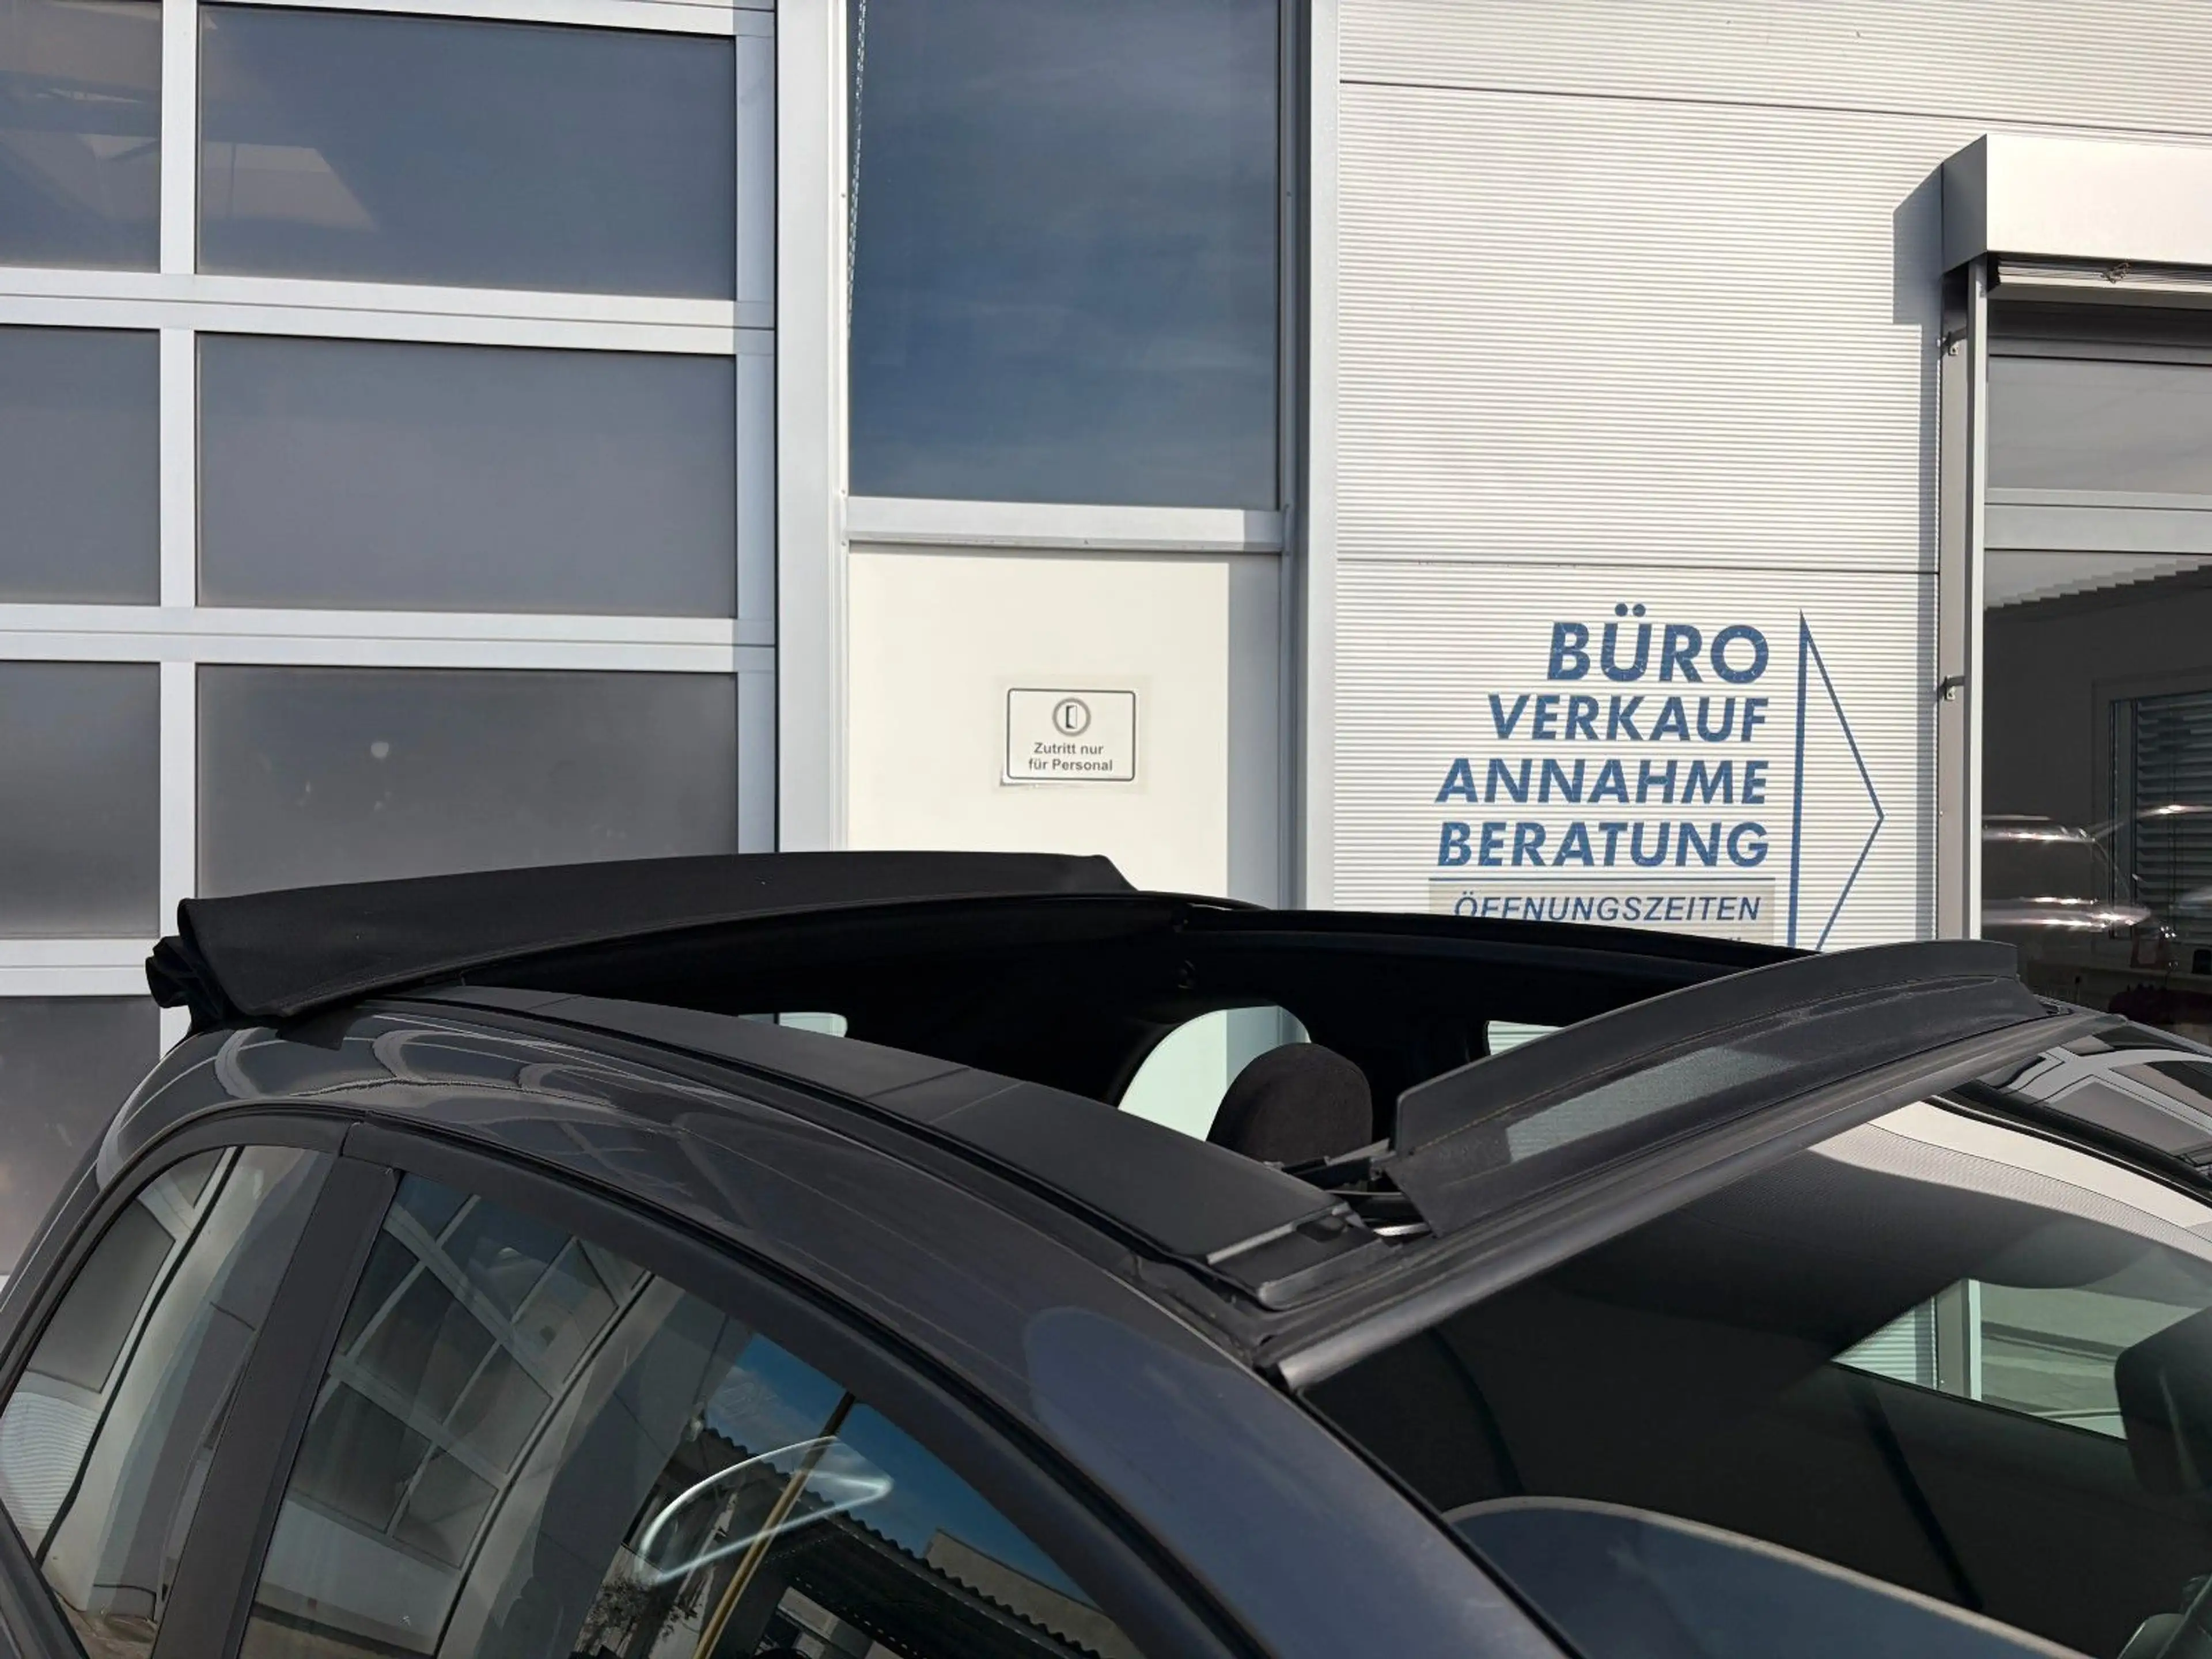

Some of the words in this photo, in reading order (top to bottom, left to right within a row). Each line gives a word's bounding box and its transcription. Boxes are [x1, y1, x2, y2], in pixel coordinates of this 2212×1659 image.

[1547, 603, 1770, 684] BÜRO
[1487, 694, 1770, 743] VERKAUF
[1028, 757, 1048, 770] für
[1052, 759, 1113, 771] Personal
[1033, 742, 1077, 755] Zutritt
[1080, 744, 1104, 755] nur
[1434, 757, 1770, 805] ANNAHME
[1437, 821, 1769, 868] BERATUNG
[1454, 891, 1762, 922] ÖFFNUNGSZEITEN
